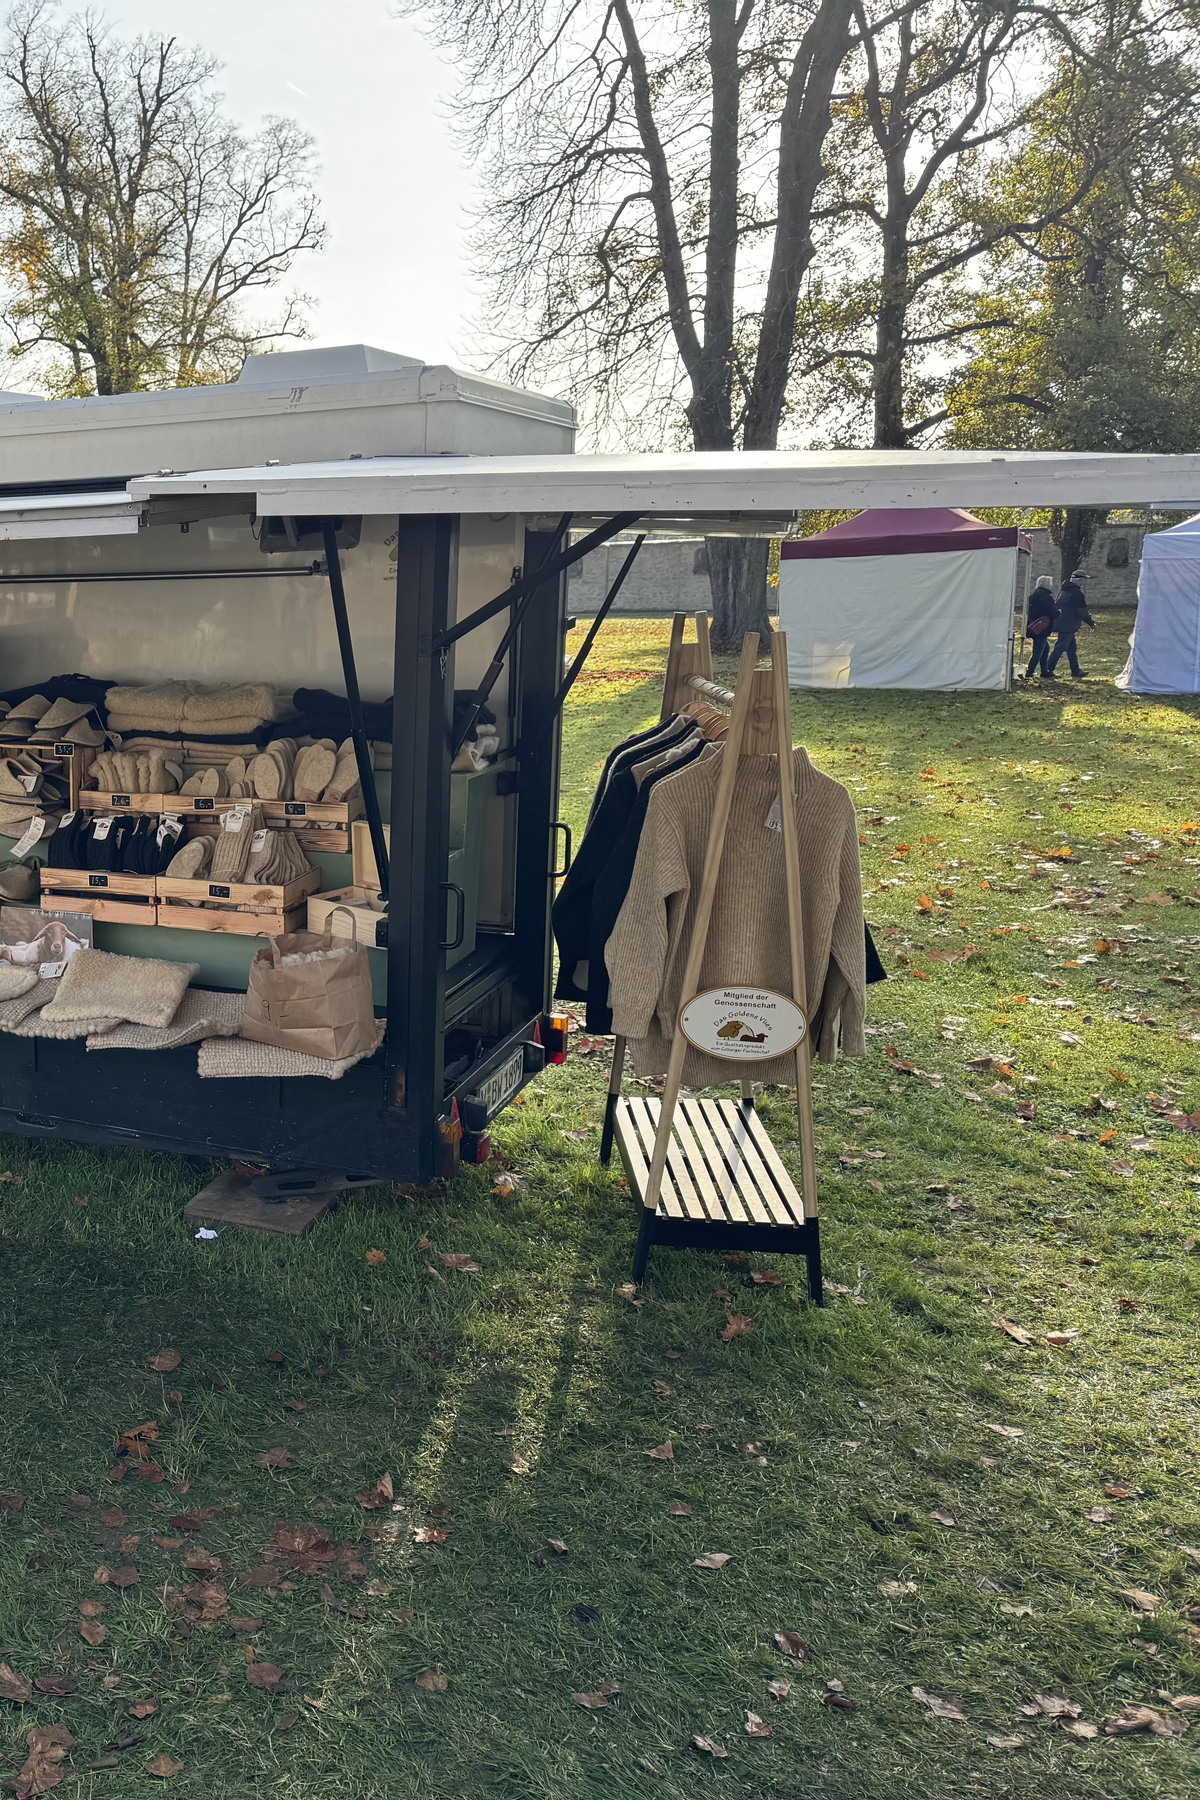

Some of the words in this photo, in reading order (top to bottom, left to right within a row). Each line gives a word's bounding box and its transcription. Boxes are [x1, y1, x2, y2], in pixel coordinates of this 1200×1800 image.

[114, 796, 130, 805] 26,-
[199, 798, 212, 809] 6,-
[288, 804, 303, 814] 8,-
[91, 876, 105, 886] 15,-
[212, 887, 228, 897] 15,-
[723, 991, 754, 1000] Mitglied
[714, 999, 777, 1009] Genossenschaft
[261, 999, 290, 1027] 9,-
[713, 1016, 727, 1027] Das
[728, 1010, 759, 1020] Goldene
[759, 1016, 773, 1031] Vlies
